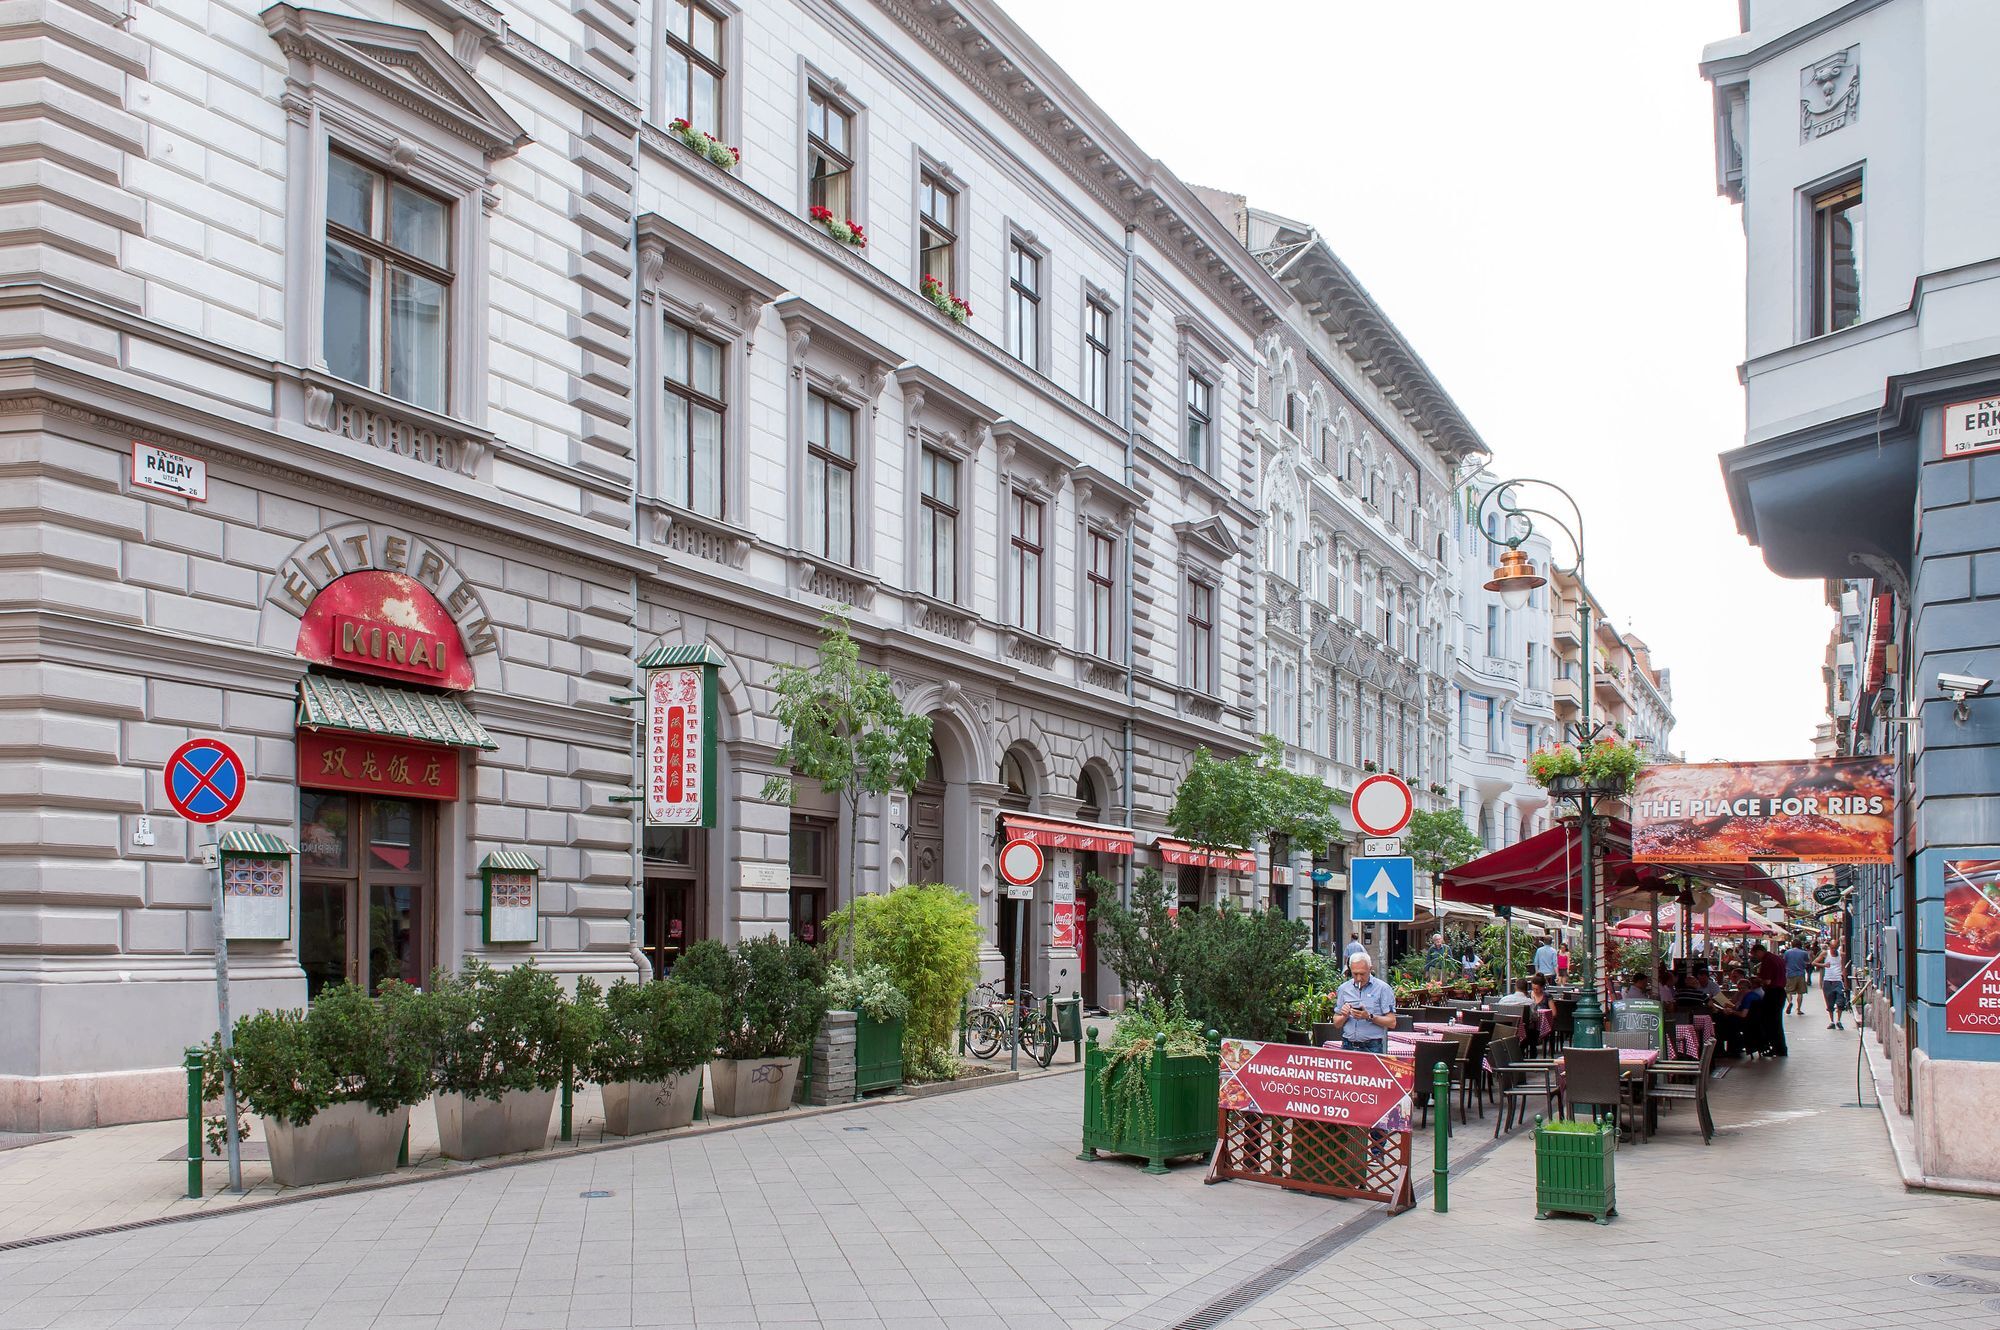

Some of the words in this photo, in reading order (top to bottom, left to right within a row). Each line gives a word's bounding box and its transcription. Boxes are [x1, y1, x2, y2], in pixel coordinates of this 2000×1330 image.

[147, 455, 192, 479] RÁDAY
[163, 475, 179, 483] UTCA
[189, 487, 198, 496] 26
[281, 534, 497, 651] ÉTTEREM
[342, 622, 446, 672] KINAI
[653, 706, 665, 803] RESTAURANT
[686, 701, 698, 803] ÉTTEREM
[320, 746, 443, 787] 双龙饭店
[1641, 799, 1681, 818] THE
[1689, 798, 1761, 817] PLACE
[1769, 797, 1819, 816] FOR
[1828, 796, 1884, 815] RIBS
[1286, 1054, 1353, 1071] AUTHENTIC
[1248, 1063, 1315, 1081] HUNGARIAN
[1317, 1072, 1393, 1090] RESTAURANT
[1303, 1087, 1378, 1105] POSTAKOCSI
[1285, 1100, 1321, 1115] ANNO
[1323, 1105, 1350, 1119] 1970
